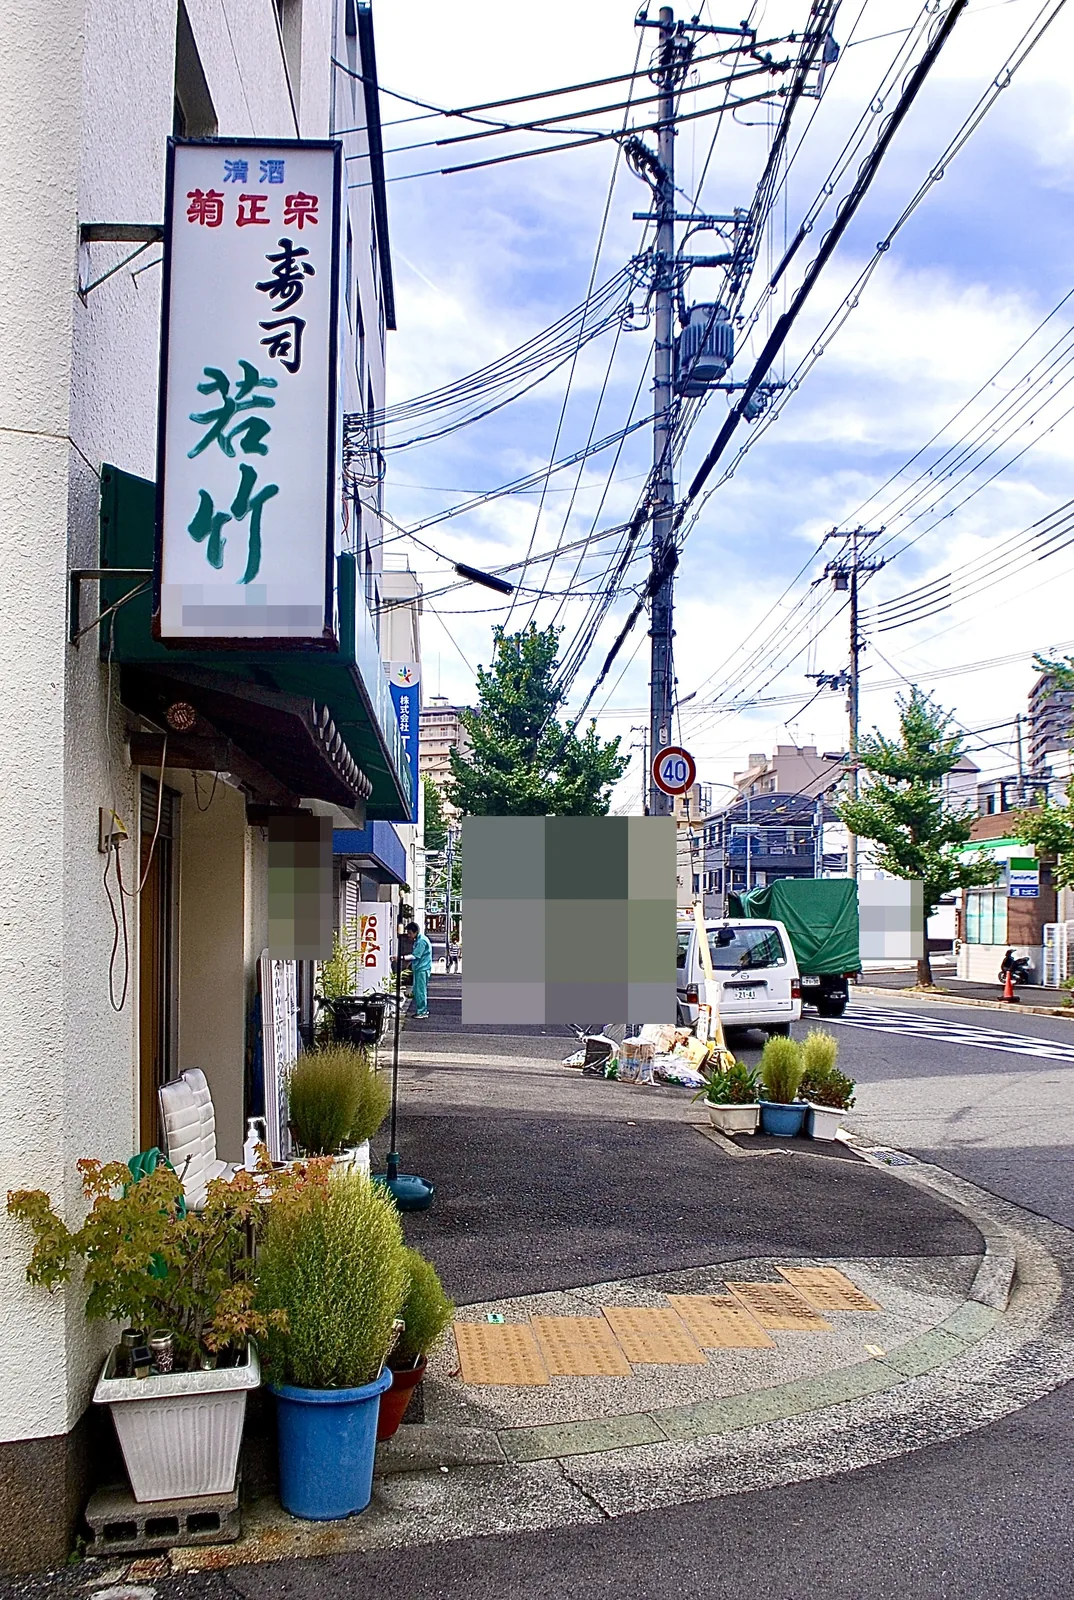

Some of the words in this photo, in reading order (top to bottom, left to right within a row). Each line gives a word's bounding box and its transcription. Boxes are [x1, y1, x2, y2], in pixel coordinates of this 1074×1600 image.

[223, 159, 285, 184] 清酒
[186, 188, 319, 229] 菊正宗
[255, 237, 316, 373] 寿司
[187, 360, 279, 585] 若竹
[399, 695, 410, 732] 株式会社
[662, 759, 687, 782] 40
